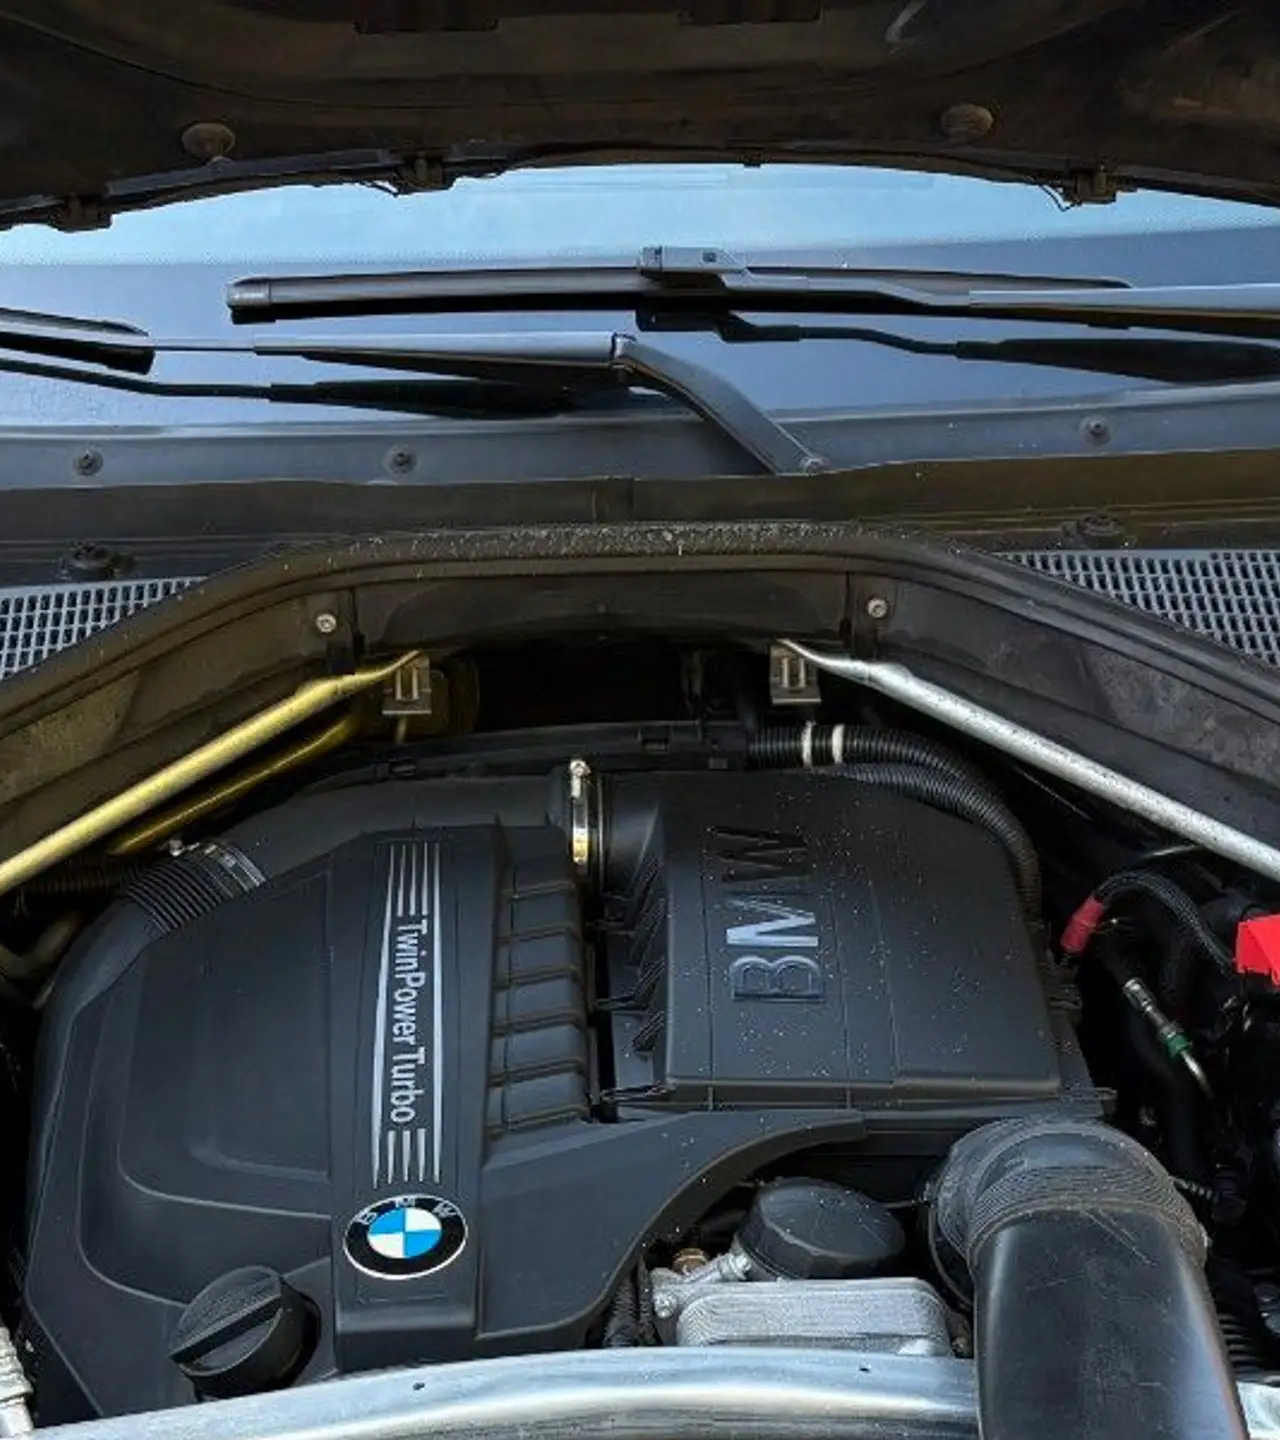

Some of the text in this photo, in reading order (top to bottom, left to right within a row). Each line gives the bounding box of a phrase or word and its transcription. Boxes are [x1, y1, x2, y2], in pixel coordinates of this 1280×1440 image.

[709, 825, 825, 1004] BMW
[389, 918, 428, 1124] TwinPower Turbo
